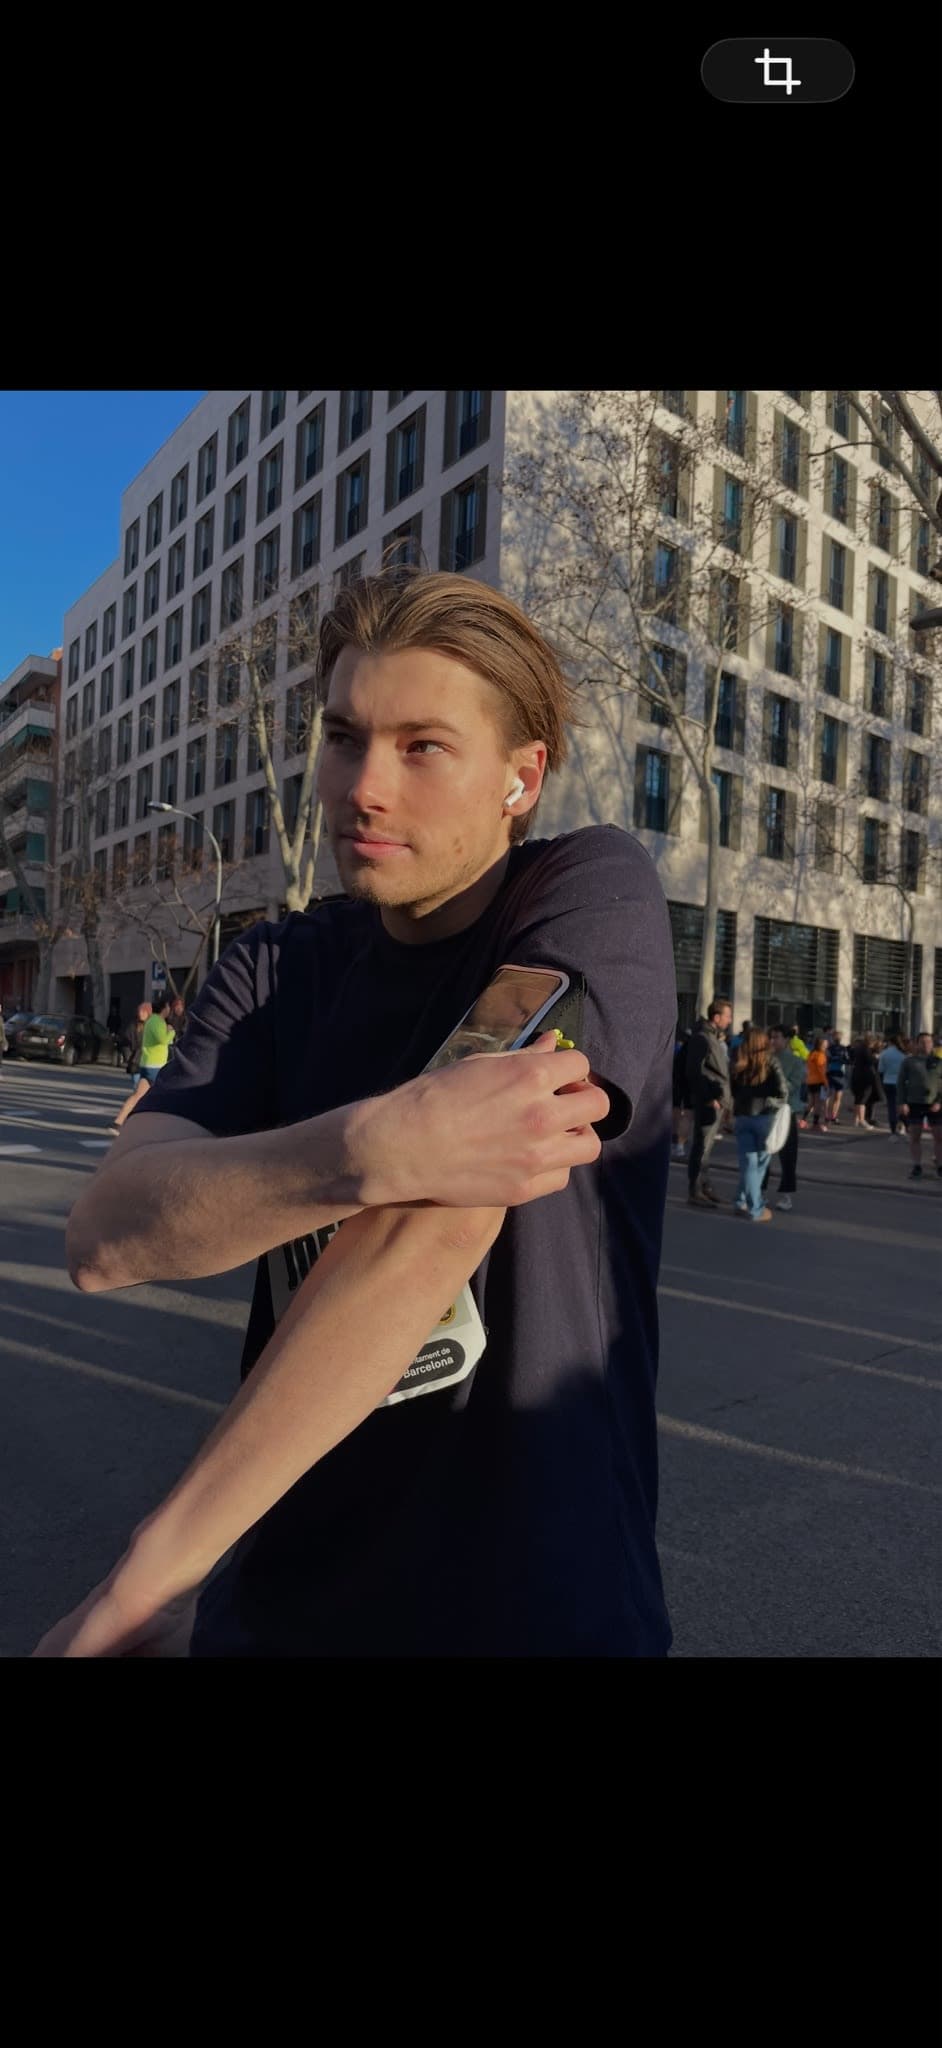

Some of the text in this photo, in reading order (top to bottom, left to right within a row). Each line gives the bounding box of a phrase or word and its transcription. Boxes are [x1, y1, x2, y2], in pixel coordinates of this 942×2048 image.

[414, 1347, 451, 1363] tament de
[403, 1356, 454, 1379] Barcelona
